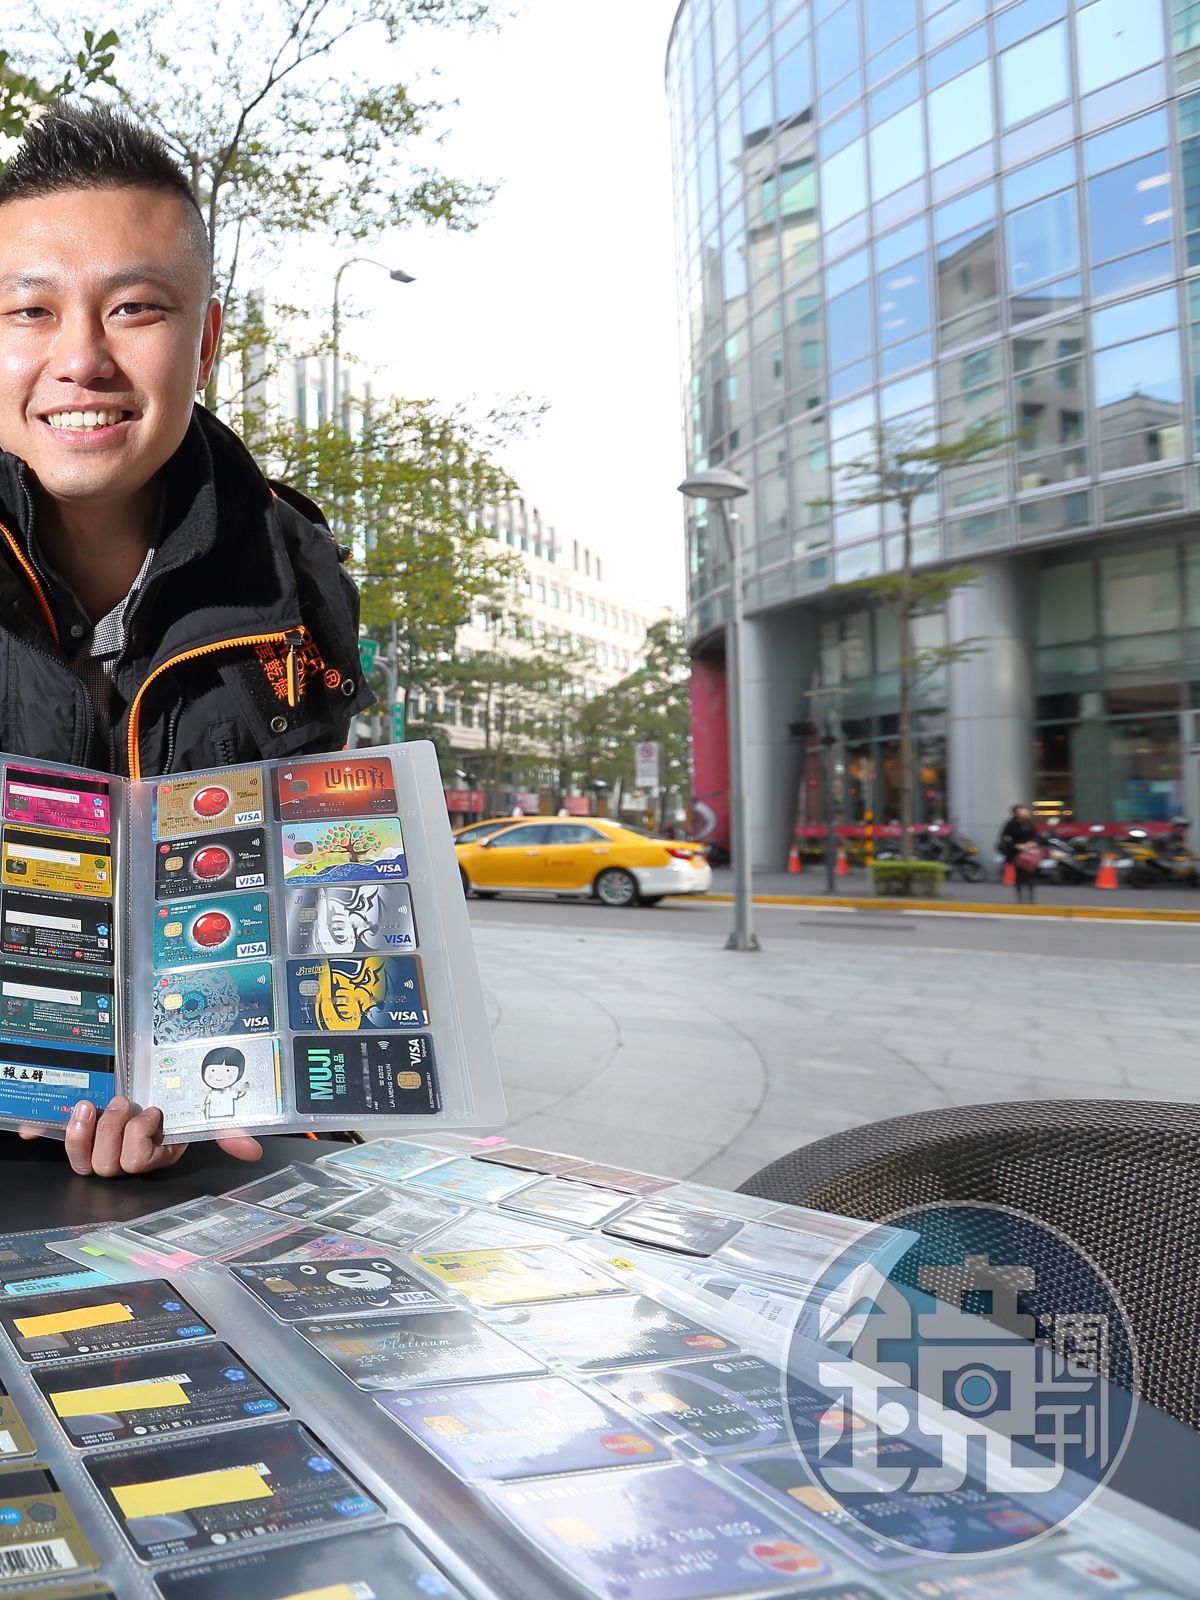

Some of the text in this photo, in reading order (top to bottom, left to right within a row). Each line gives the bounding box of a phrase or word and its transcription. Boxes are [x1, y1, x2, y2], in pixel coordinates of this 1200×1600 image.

[237, 812, 260, 822] VISA
[375, 864, 402, 873] VISA
[239, 876, 263, 886] VISA
[383, 934, 412, 943] VISA
[240, 944, 264, 955] VISA
[242, 1016, 269, 1027] VISA
[387, 1011, 419, 1021] VISA
[408, 1038, 422, 1067] VISA
[308, 1049, 334, 1100] MUJI
[333, 1053, 347, 1095] 無印良品
[14, 1282, 62, 1293] POINT
[399, 1292, 437, 1302] VISA
[91, 1341, 131, 1352] 玉山銀行
[377, 1338, 451, 1351] Platinum
[248, 1402, 273, 1411] Cirrus
[148, 1419, 193, 1433] 玉山銀行
